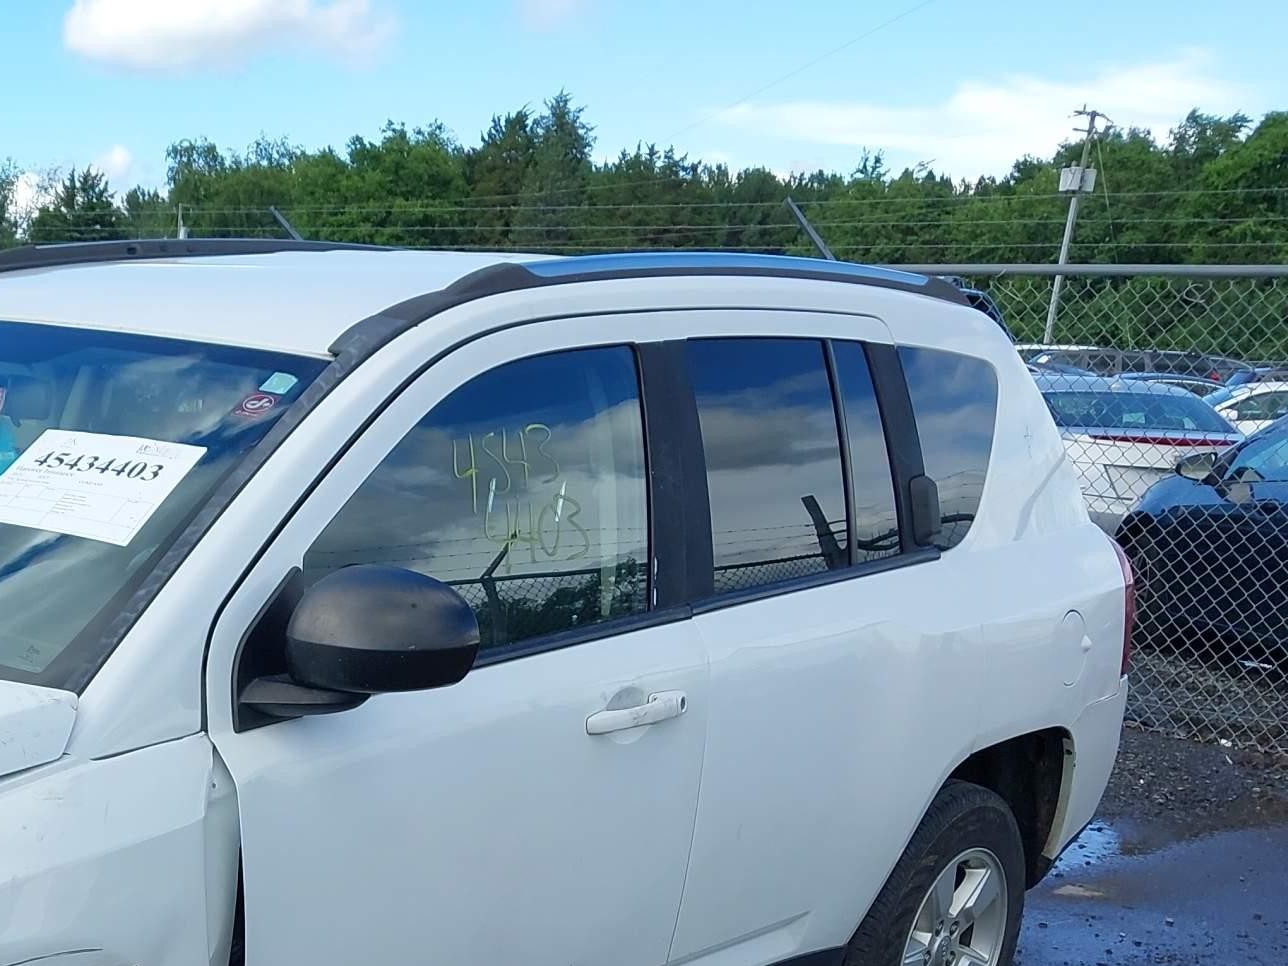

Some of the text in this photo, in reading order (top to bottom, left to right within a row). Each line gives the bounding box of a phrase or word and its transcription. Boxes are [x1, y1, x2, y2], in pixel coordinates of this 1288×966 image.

[34, 449, 165, 482] 45434403
[452, 423, 561, 513] 4543
[483, 493, 590, 574] 4403
